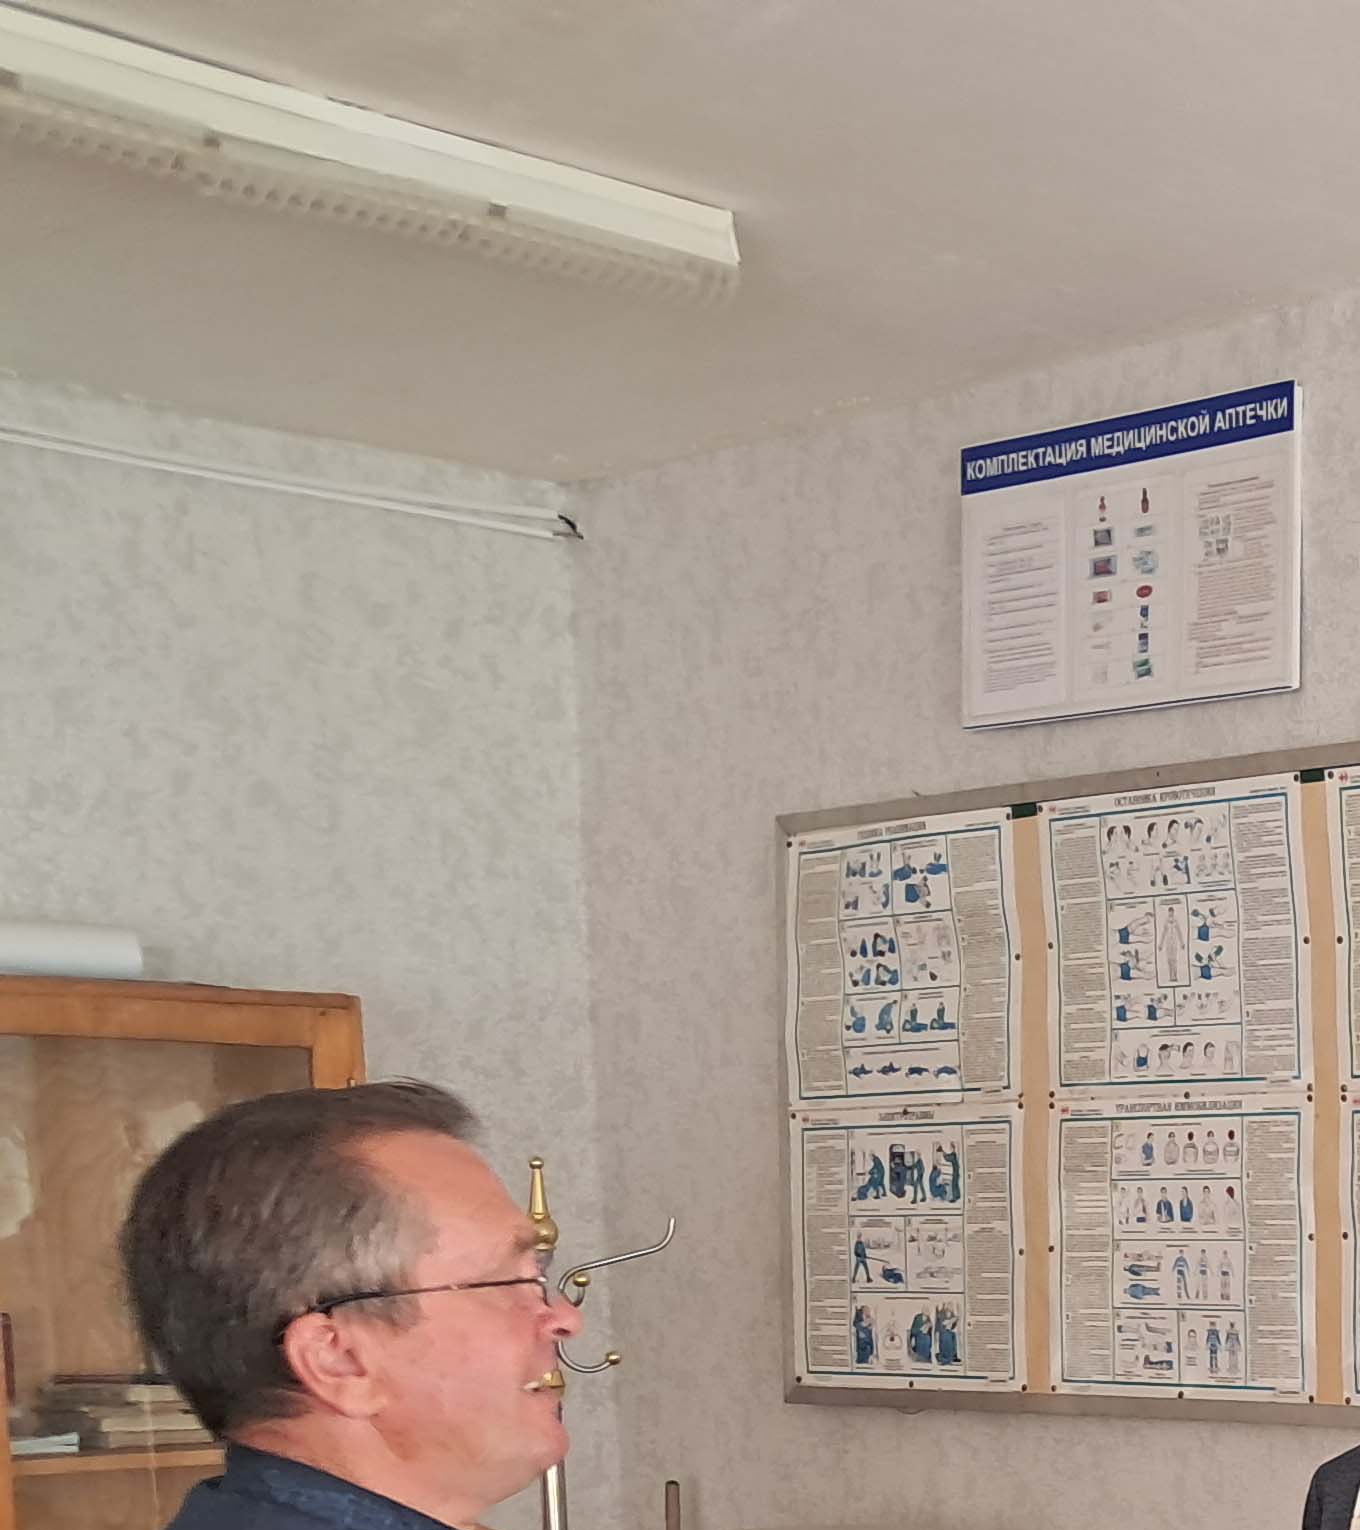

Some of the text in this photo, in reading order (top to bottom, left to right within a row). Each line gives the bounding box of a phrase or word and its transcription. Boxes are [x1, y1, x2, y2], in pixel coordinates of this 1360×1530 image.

[966, 396, 1288, 480] КОМПЛЕКТАЦИЯ МЕДИЦИНСКОЙ АПТЕЧКИ
